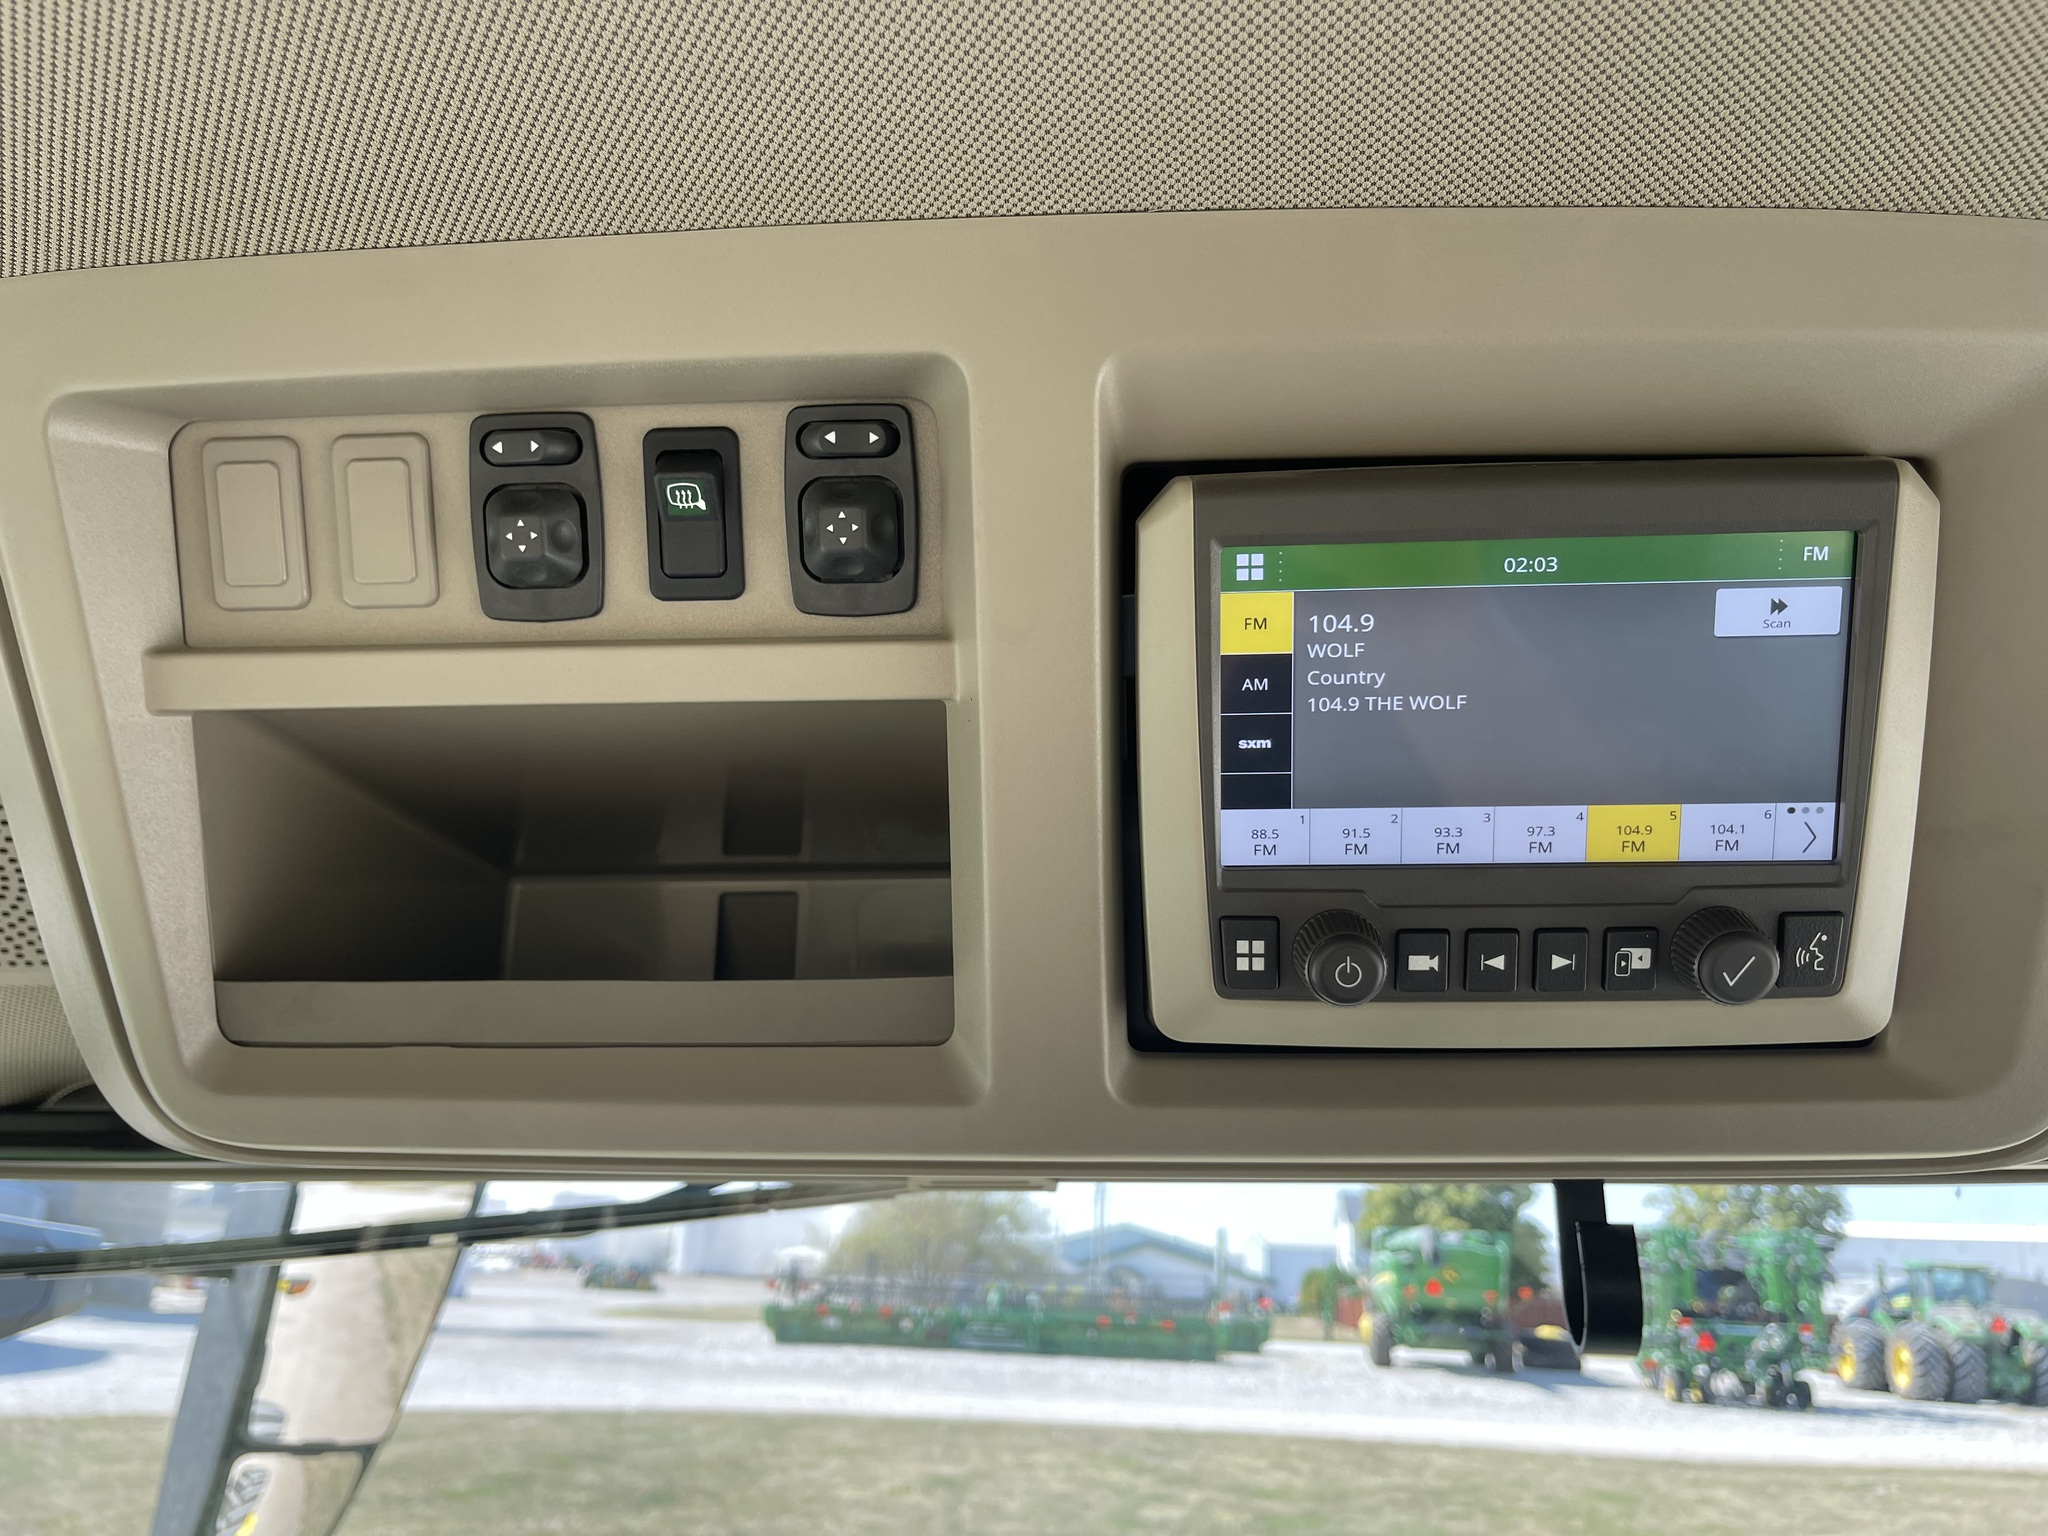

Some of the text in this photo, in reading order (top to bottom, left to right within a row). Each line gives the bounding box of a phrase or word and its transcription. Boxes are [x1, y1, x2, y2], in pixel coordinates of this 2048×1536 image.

[1802, 545, 1829, 562] FM
[1503, 556, 1558, 573] 02:03
[1244, 617, 1267, 631] FM
[1309, 613, 1375, 634] 104.9
[1762, 619, 1791, 629] Scan
[1306, 642, 1365, 659] WOLF
[1241, 677, 1268, 692] AM
[1307, 670, 1386, 689] Country
[1307, 694, 1468, 713] 104.9 THE WOLF
[1299, 814, 1305, 825] 1
[1390, 813, 1399, 824] 2
[1483, 812, 1491, 823] 3
[1575, 811, 1584, 822] 4
[1669, 810, 1677, 821] 5
[1764, 809, 1772, 820] 6
[1251, 828, 1280, 840] 88.5
[1342, 827, 1371, 839] 91.5
[1434, 826, 1463, 838] 93.3
[1526, 825, 1556, 837] 97.3
[1616, 824, 1653, 836] 104.9
[1710, 824, 1745, 835] 104.1
[1254, 844, 1277, 856] FM
[1344, 843, 1368, 856] FM
[1436, 842, 1460, 855] FM
[1529, 841, 1553, 854] FM
[1621, 840, 1645, 853] FM
[1715, 839, 1739, 852] FM
